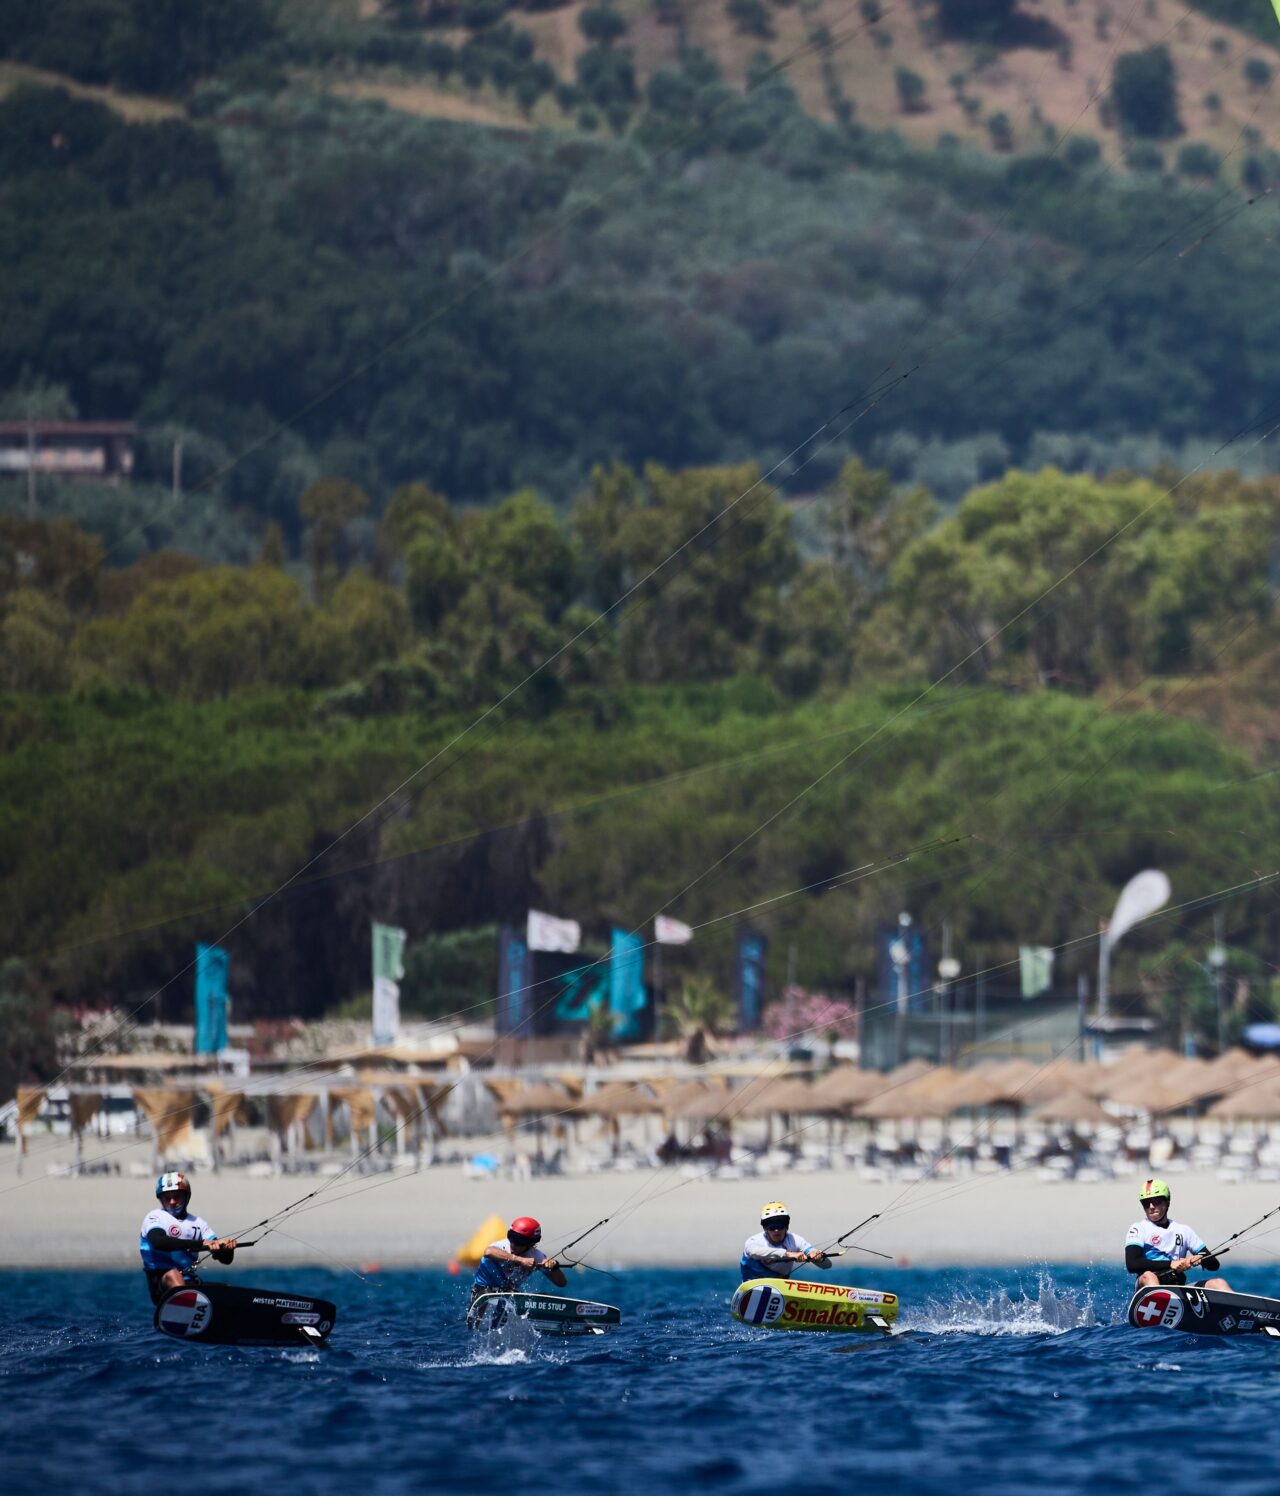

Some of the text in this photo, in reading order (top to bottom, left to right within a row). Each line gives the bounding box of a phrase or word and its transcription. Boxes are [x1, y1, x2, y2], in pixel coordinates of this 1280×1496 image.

[1175, 1233, 1184, 1247] 81
[252, 1297, 275, 1305] MISTER
[538, 1302, 547, 1310] DE
[548, 1302, 567, 1311] STULP
[765, 1296, 781, 1320] NED
[191, 1304, 208, 1330] FRA
[782, 1300, 859, 1326] Sinalco
[1163, 1305, 1180, 1326] SUI
